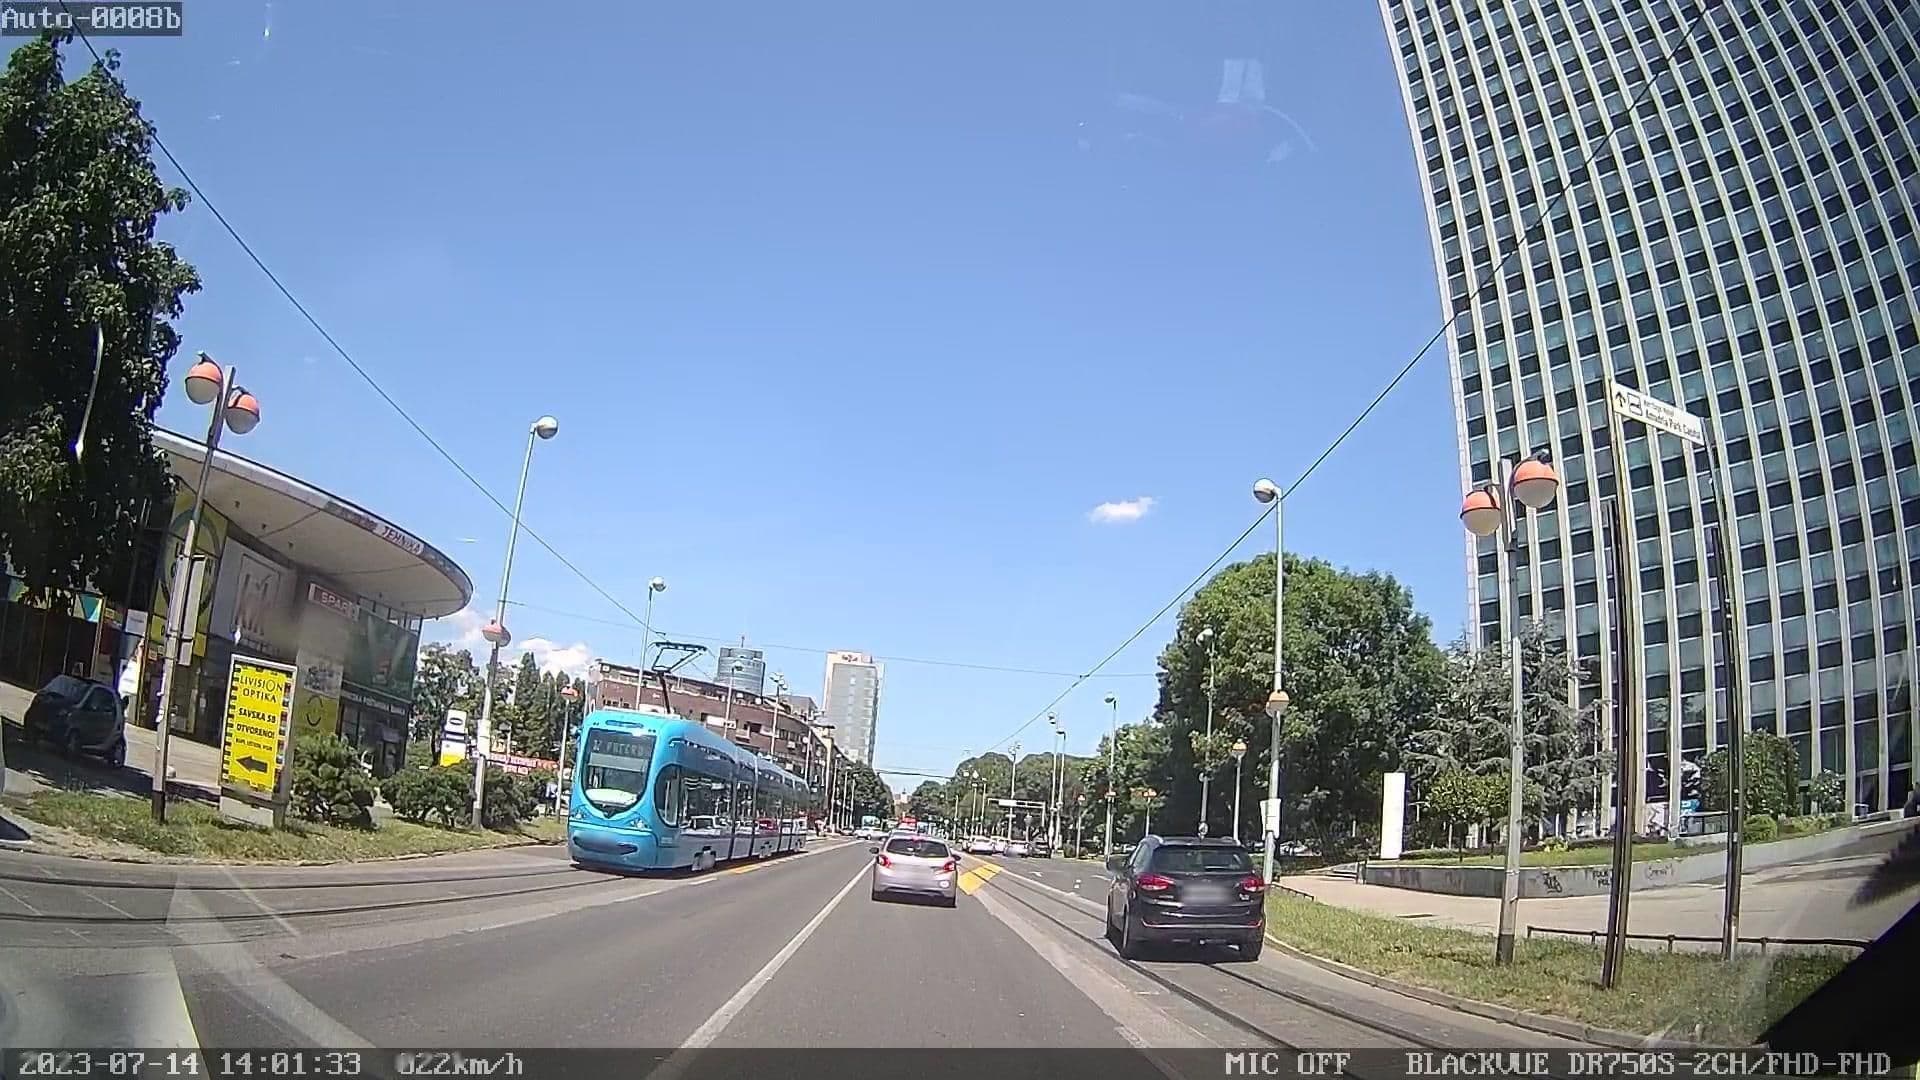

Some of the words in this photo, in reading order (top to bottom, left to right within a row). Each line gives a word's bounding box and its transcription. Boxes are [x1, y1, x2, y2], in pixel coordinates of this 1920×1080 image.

[321, 591, 349, 612] SPAR
[239, 675, 283, 692] LIVISION
[243, 687, 277, 704] OPTIKA
[238, 707, 266, 722] SAVSKA
[236, 723, 275, 740] OTVORENO!
